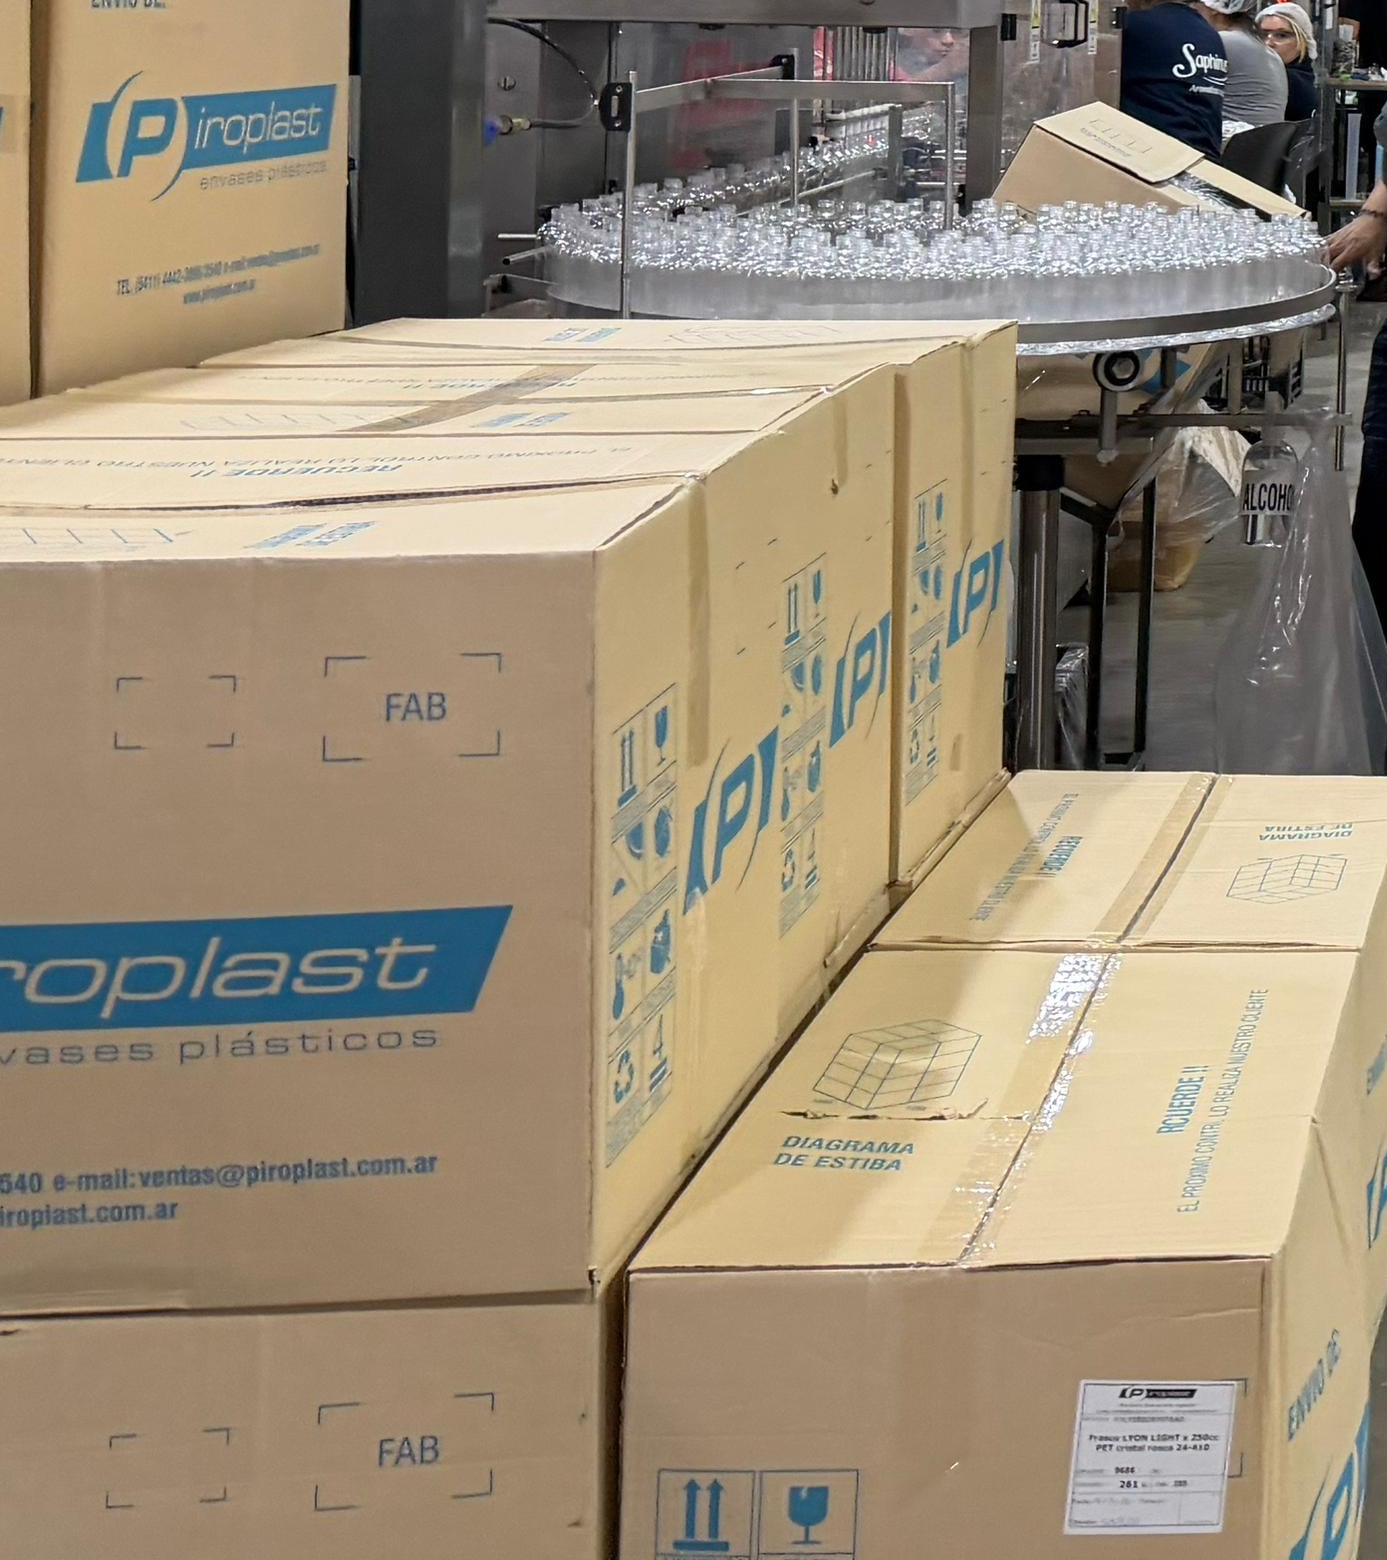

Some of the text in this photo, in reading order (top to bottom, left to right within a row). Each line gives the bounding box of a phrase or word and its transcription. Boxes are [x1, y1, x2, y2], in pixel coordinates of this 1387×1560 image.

[200, 170, 263, 191] envases
[385, 691, 448, 722] FAB
[1258, 830, 1353, 841] DIAGRAMA
[1240, 988, 1270, 1024] CLIENTE
[179, 1027, 438, 1065] plásticos
[1227, 1023, 1258, 1066] NUESTRO
[1212, 1066, 1242, 1106] REALIZA
[1207, 1105, 1230, 1123] LO
[782, 1135, 915, 1155] DIAGRAMA
[773, 1153, 903, 1172] DE ESTIBA
[1176, 1199, 1201, 1213] EL
[1095, 1444, 1113, 1452] PET
[1151, 1434, 1180, 1442] LIGHT
[377, 1435, 440, 1468] FAB
